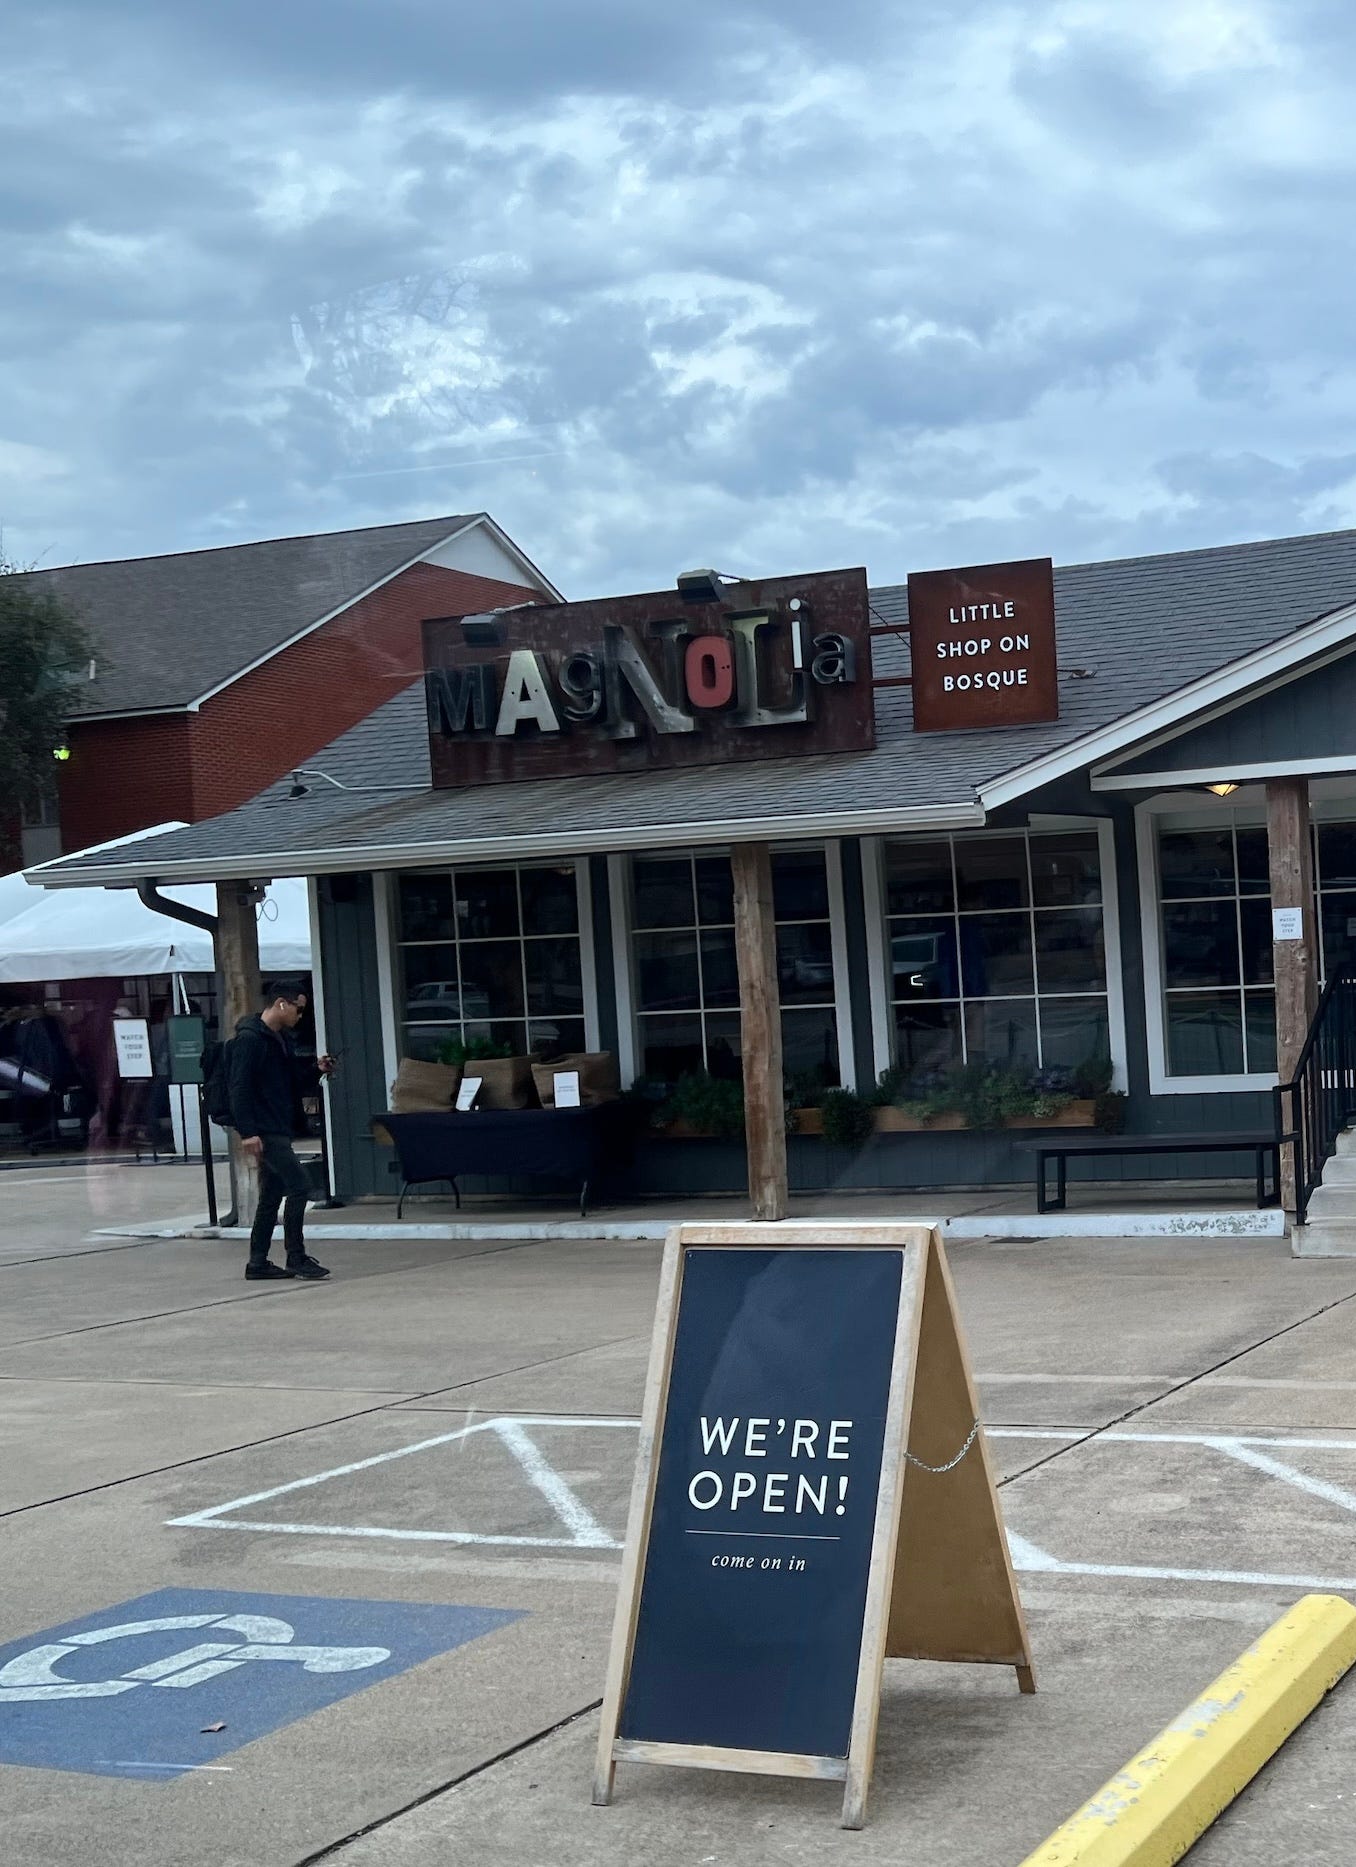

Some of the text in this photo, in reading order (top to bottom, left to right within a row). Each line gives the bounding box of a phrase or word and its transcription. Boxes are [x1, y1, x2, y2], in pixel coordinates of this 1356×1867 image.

[949, 601, 1015, 624] LITTLE
[936, 634, 1030, 659] SHOP ON
[943, 668, 1028, 692] BOSQUE
[688, 1470, 849, 1516] OPEN!
[711, 1555, 806, 1571] come on in
